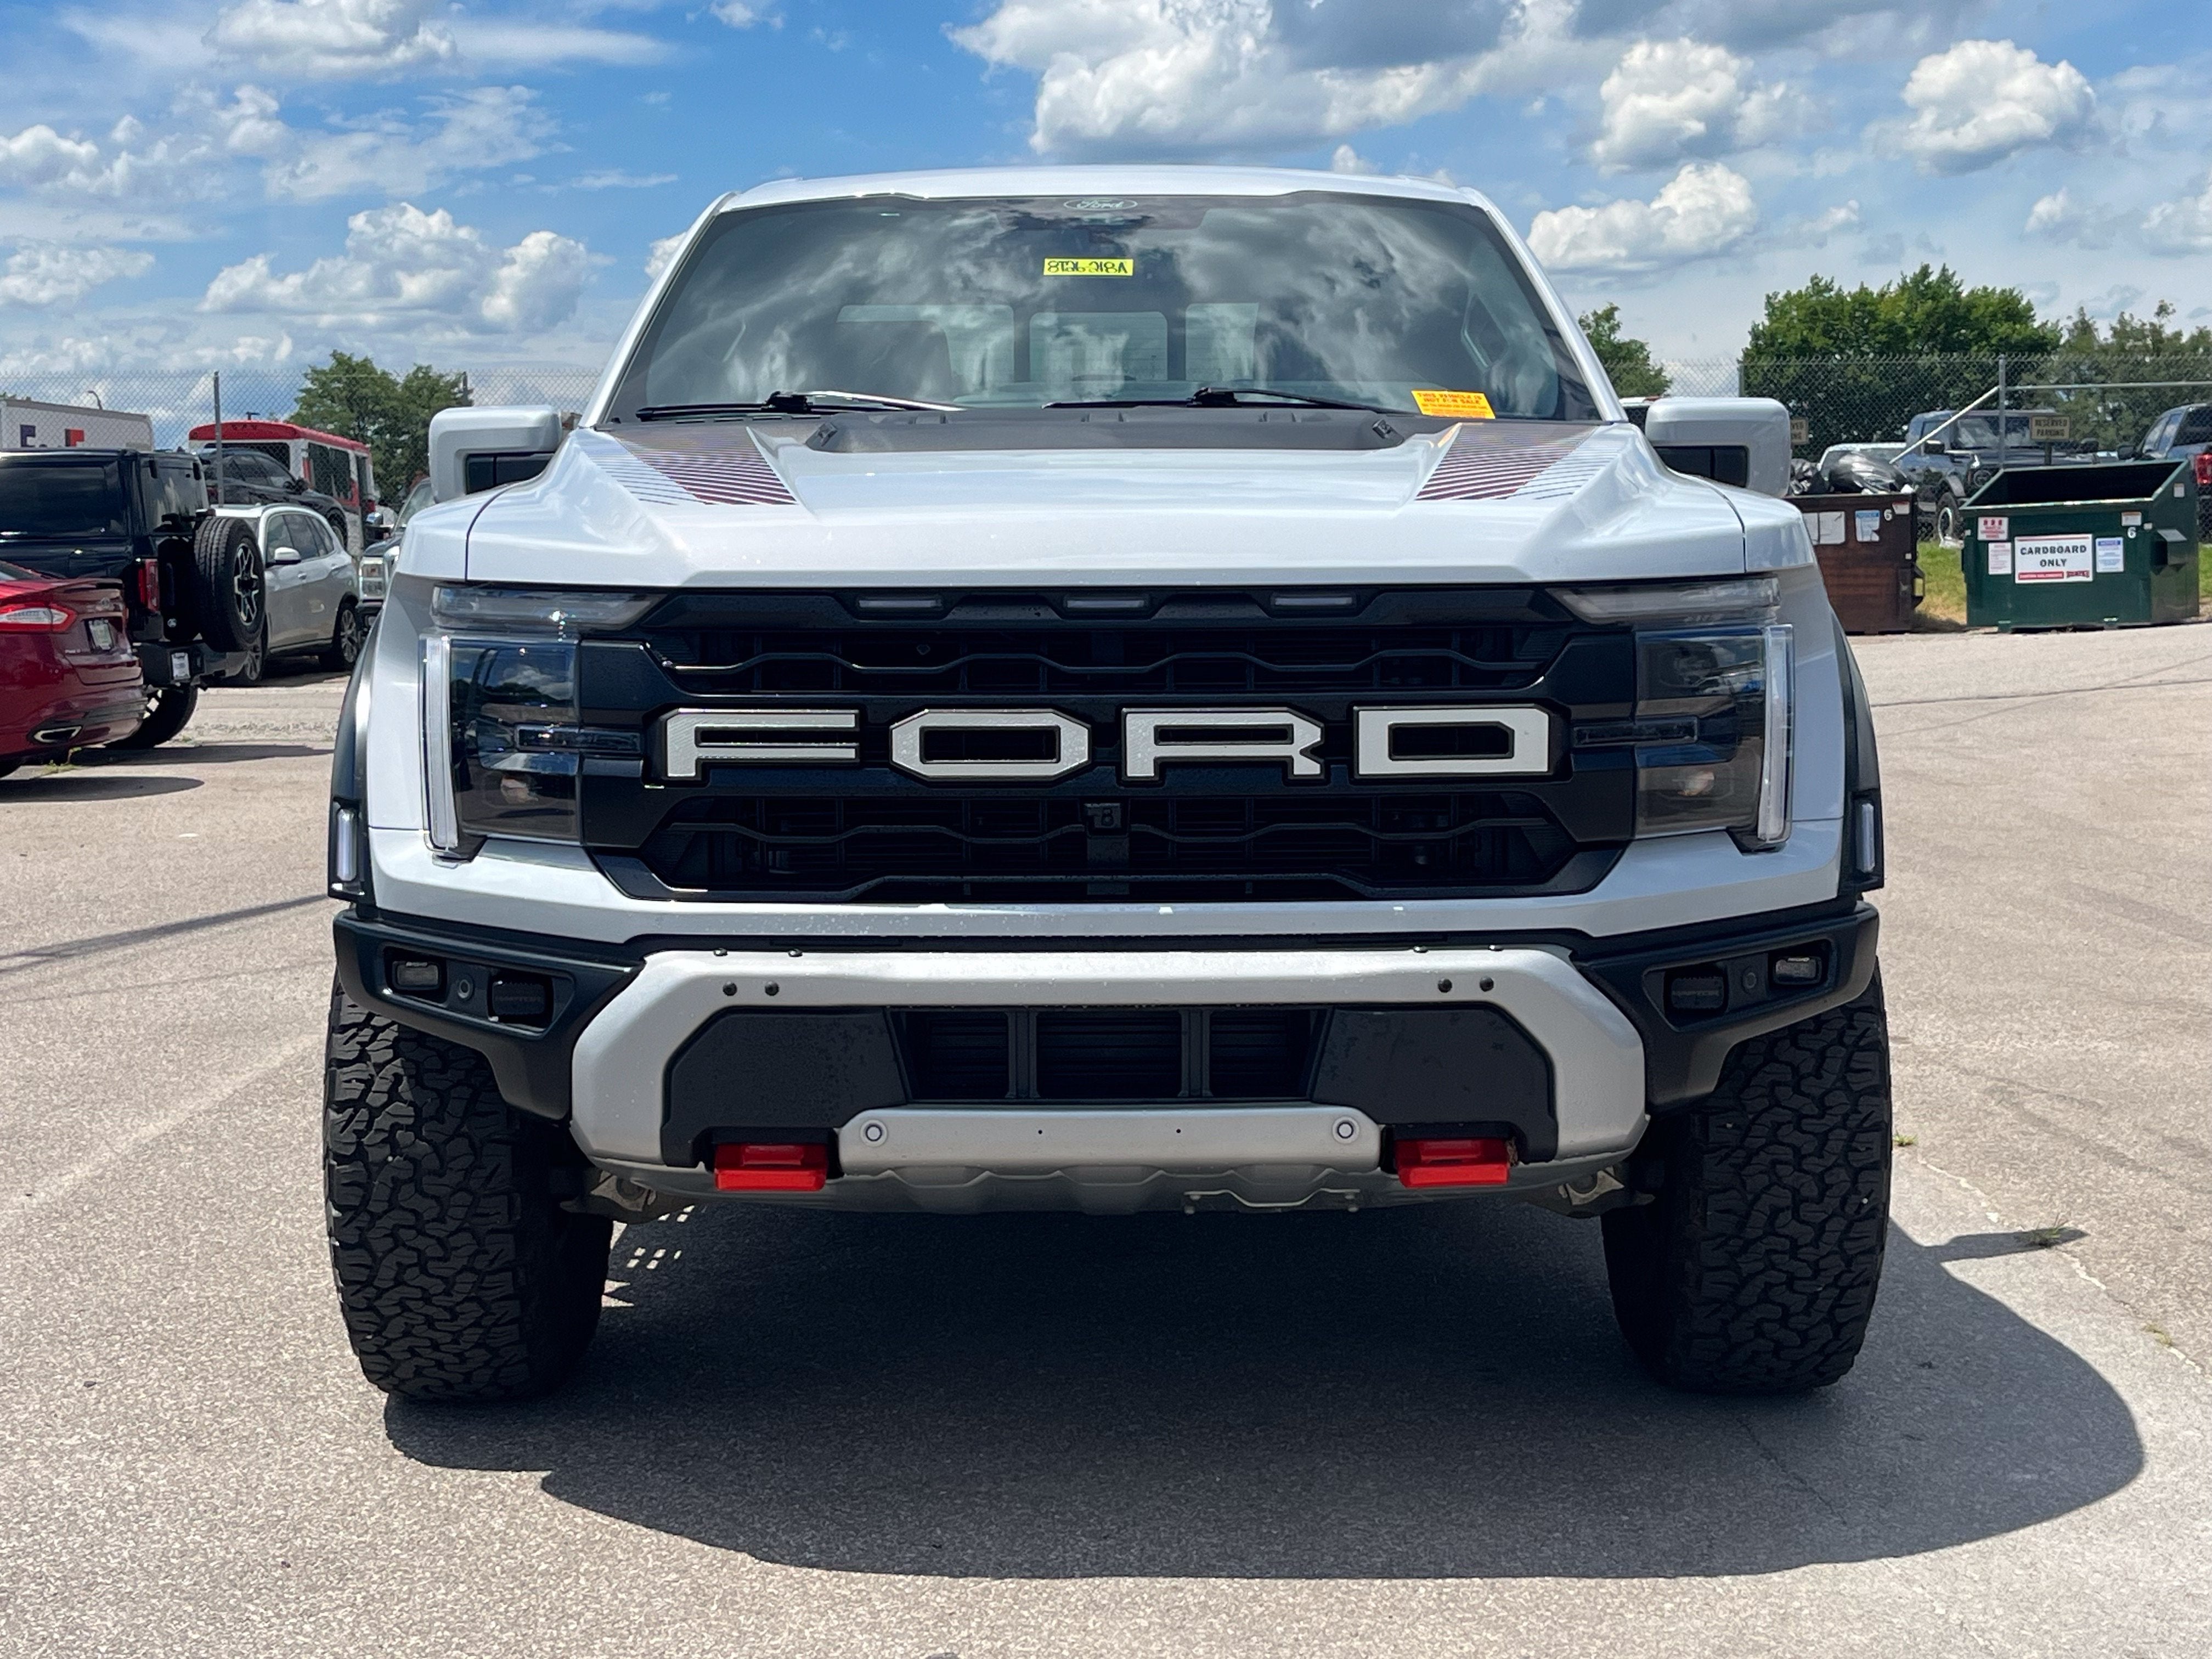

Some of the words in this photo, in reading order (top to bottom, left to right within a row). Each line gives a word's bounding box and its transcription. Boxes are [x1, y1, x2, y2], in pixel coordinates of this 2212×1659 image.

[1076, 199, 1124, 208] Ford
[1884, 509, 1892, 521] 6
[2128, 527, 2136, 539] 6
[2020, 545, 2087, 555] CARDBOARD
[2040, 558, 2067, 567] ONLY
[666, 708, 1551, 780] FORD
